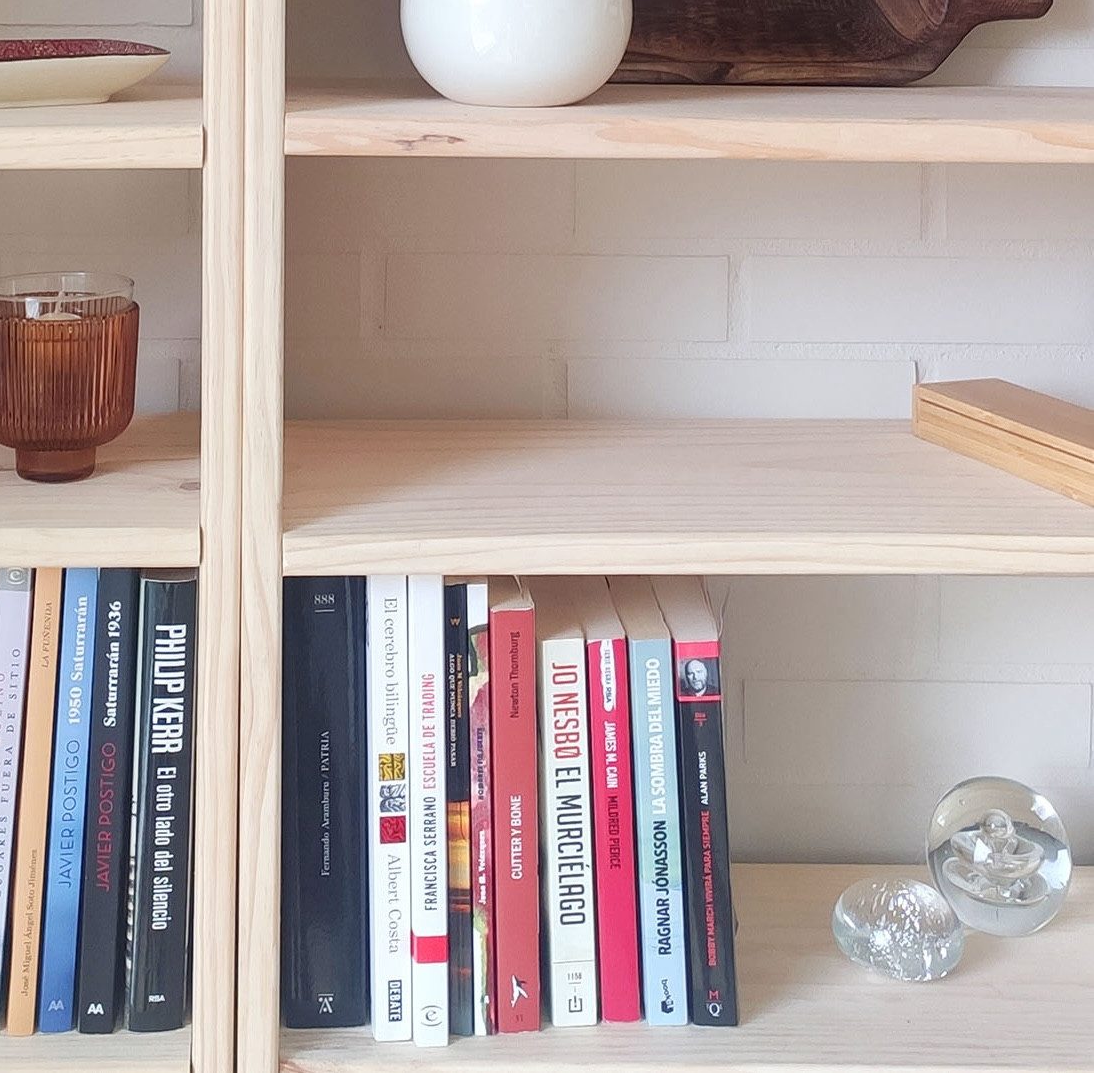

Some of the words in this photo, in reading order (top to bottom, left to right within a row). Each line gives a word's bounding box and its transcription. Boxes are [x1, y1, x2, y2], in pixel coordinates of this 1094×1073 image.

[107, 600, 122, 638] 1936
[314, 594, 335, 605] 888
[384, 597, 398, 614] El
[70, 595, 88, 682] Saturrarán
[153, 623, 187, 693] PHILIP
[384, 617, 399, 678] cerebro
[8, 648, 21, 700] SITIO
[41, 655, 50, 669] LA
[551, 662, 578, 685] JO
[645, 658, 661, 705] MIEDO
[102, 641, 121, 727] Saturrarán
[421, 673, 436, 721] TRADING
[509, 682, 521, 719] Newton
[6, 712, 16, 733] DE
[68, 686, 83, 725] 1950
[382, 682, 400, 745] bilingüe
[648, 705, 663, 733] DEL
[151, 697, 185, 754] KERR
[422, 725, 436, 739] DE
[552, 693, 583, 759] NESBØ
[603, 720, 617, 752] JAMES
[320, 730, 330, 772] PATRIA
[422, 742, 437, 790] ESCUELA
[605, 752, 617, 765] M.
[650, 734, 666, 796] SOMBRA
[698, 751, 708, 780] PARKS
[0, 746, 13, 804] FUERA
[61, 739, 80, 822] POSTIGO
[98, 742, 117, 825] POSTIGO
[156, 766, 177, 780] El
[555, 766, 581, 789] EL
[606, 766, 618, 789] CAIN
[155, 784, 175, 812] otro
[320, 781, 330, 830] Aramburu
[510, 794, 523, 827] BONE
[652, 797, 666, 814] LA
[700, 781, 709, 806] ALAN
[154, 816, 175, 846] lado
[422, 796, 437, 847] SERRANO
[510, 830, 522, 838] Y
[607, 795, 620, 836] MILDRED
[700, 810, 712, 849] SIEMPRE
[58, 828, 75, 889] JAVIER
[96, 830, 112, 893] JAVIER
[153, 850, 174, 872] del
[320, 832, 330, 876] Fernando
[510, 837, 524, 880] CUTTER
[555, 794, 590, 926] MURCIÉLAGO
[609, 837, 621, 870] PIERCE
[652, 820, 669, 896] JÓNASSON
[703, 849, 713, 873] PARA
[387, 853, 402, 903] Albert
[423, 850, 438, 911] FRANCISCA
[702, 874, 714, 903] VIVIRÁ
[26, 889, 35, 911] Soto
[151, 876, 174, 931] silencio
[23, 912, 35, 939] Ángel
[388, 908, 402, 954] Costa
[656, 898, 672, 956] RAGNAR
[705, 904, 717, 936] MARCH
[22, 941, 33, 974] Miguel
[706, 936, 718, 966] BOBBY
[20, 975, 29, 997] José
[389, 980, 402, 1022] DEBATE
